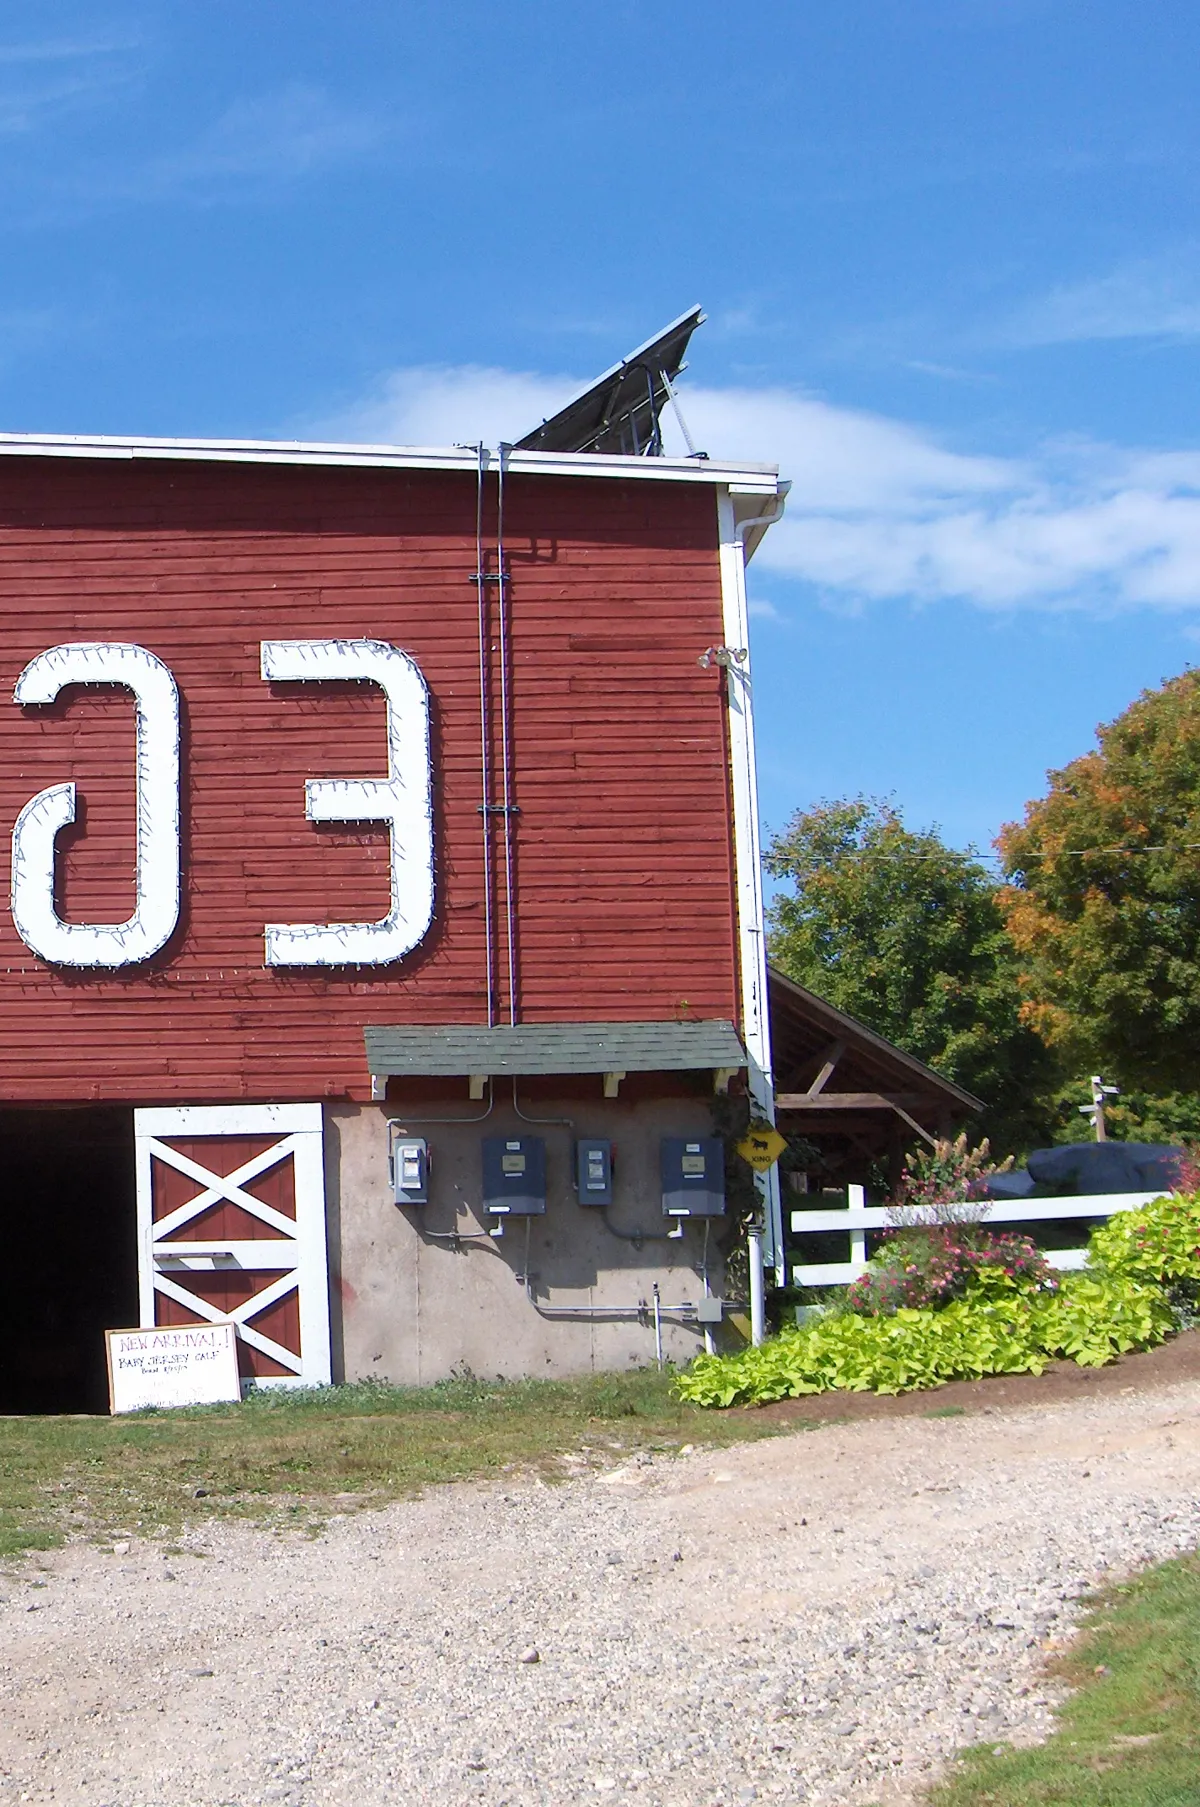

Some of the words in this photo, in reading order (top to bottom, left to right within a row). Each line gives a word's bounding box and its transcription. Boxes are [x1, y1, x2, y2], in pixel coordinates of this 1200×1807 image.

[120, 1336, 148, 1353] NEW
[118, 1356, 145, 1369] BABY
[147, 1353, 189, 1366] JERSEY
[194, 1350, 220, 1361] CALF
